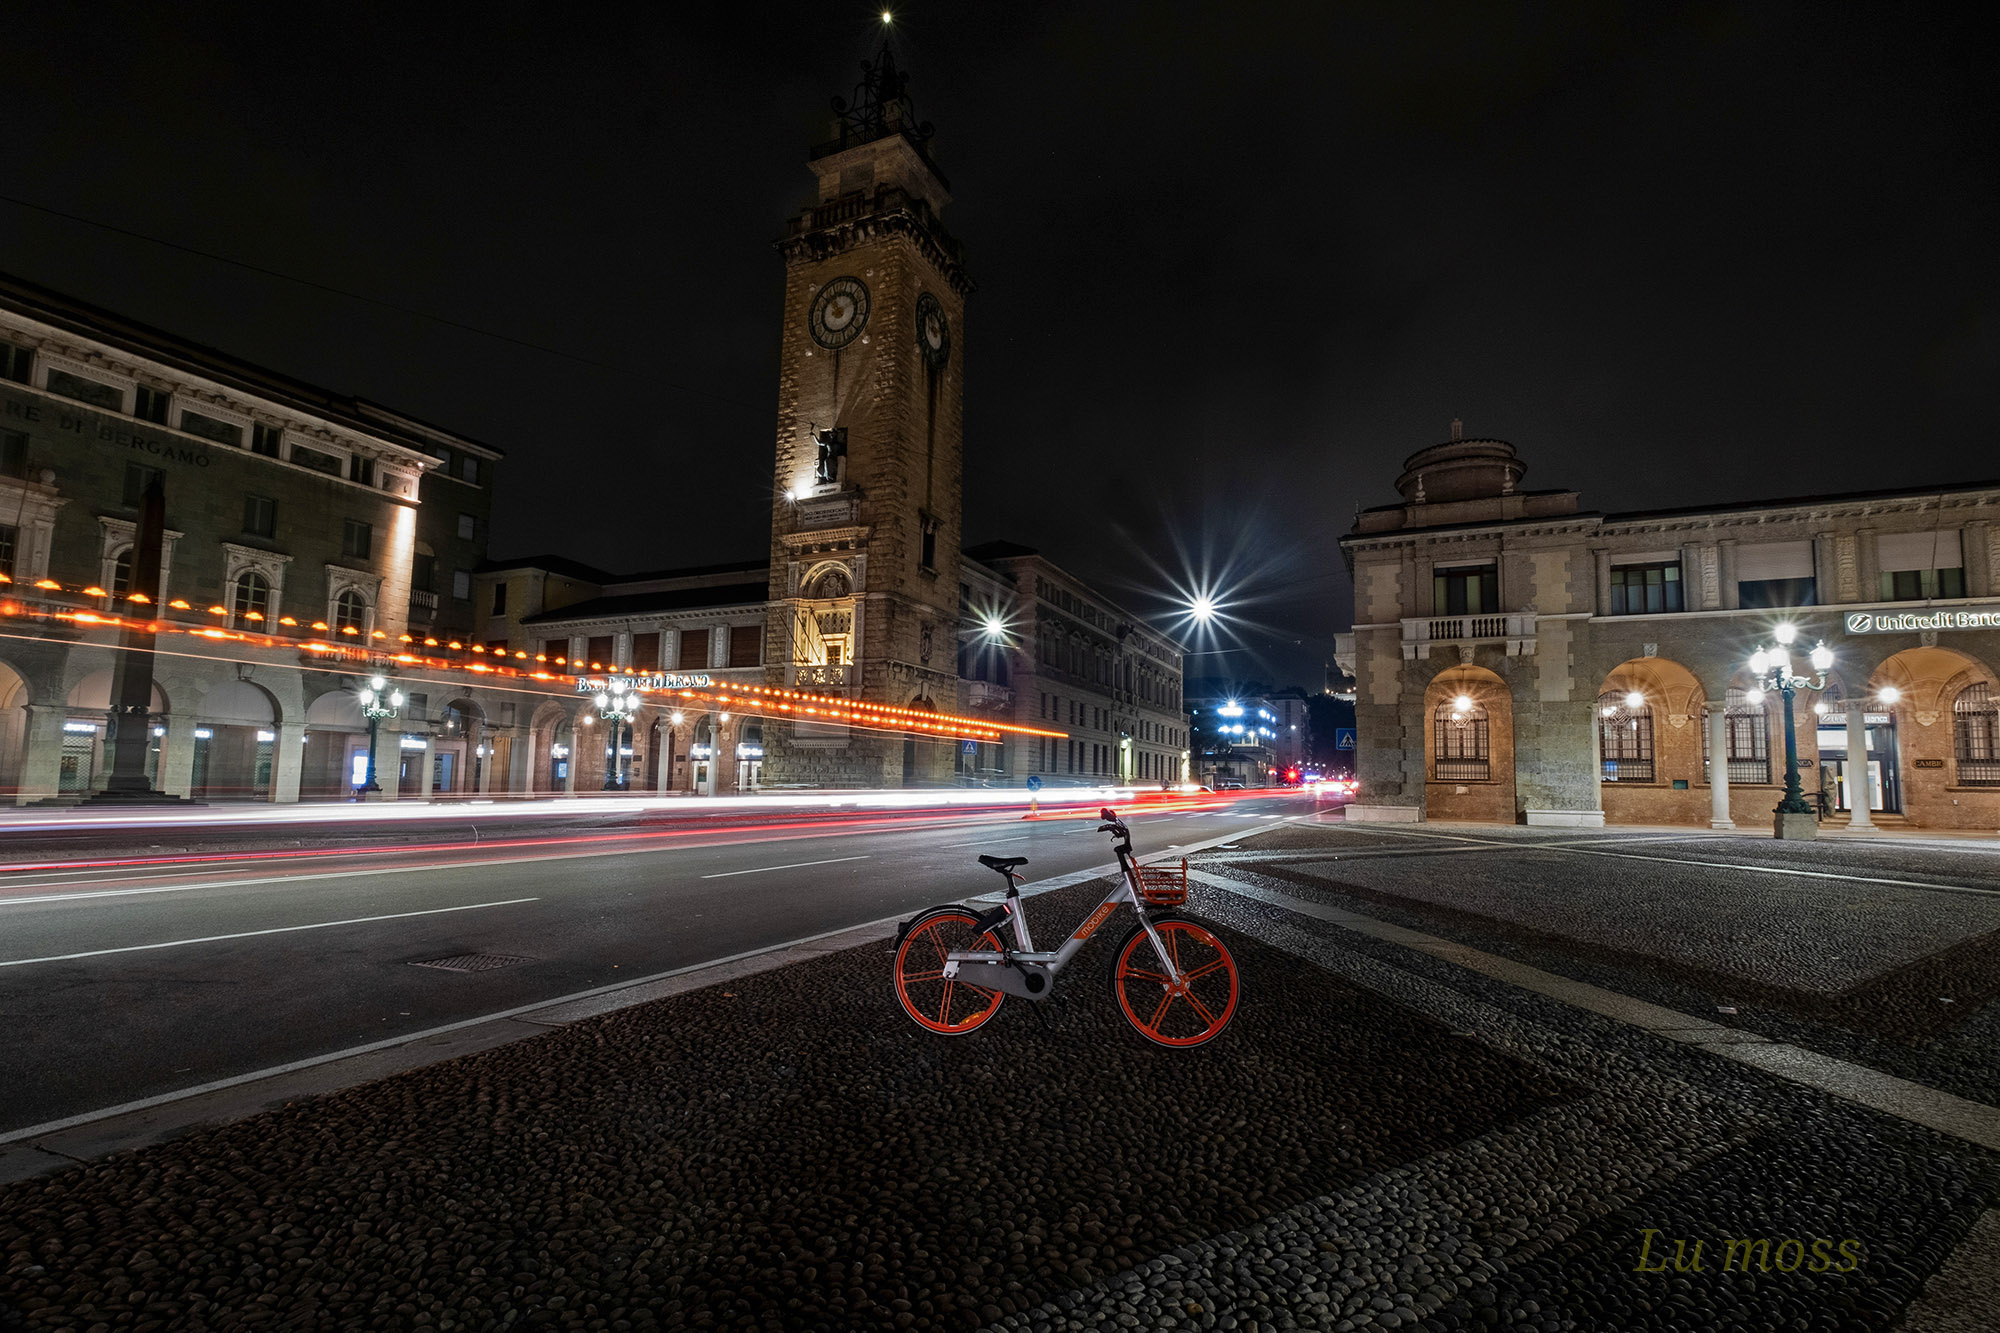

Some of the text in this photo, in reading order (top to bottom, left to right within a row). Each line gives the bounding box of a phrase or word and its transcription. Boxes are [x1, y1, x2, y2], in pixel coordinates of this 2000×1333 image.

[60, 413, 82, 433] DI
[99, 426, 211, 468] BERGAMO
[1876, 612, 1954, 630] UniCredit
[1081, 906, 1109, 936] mobike
